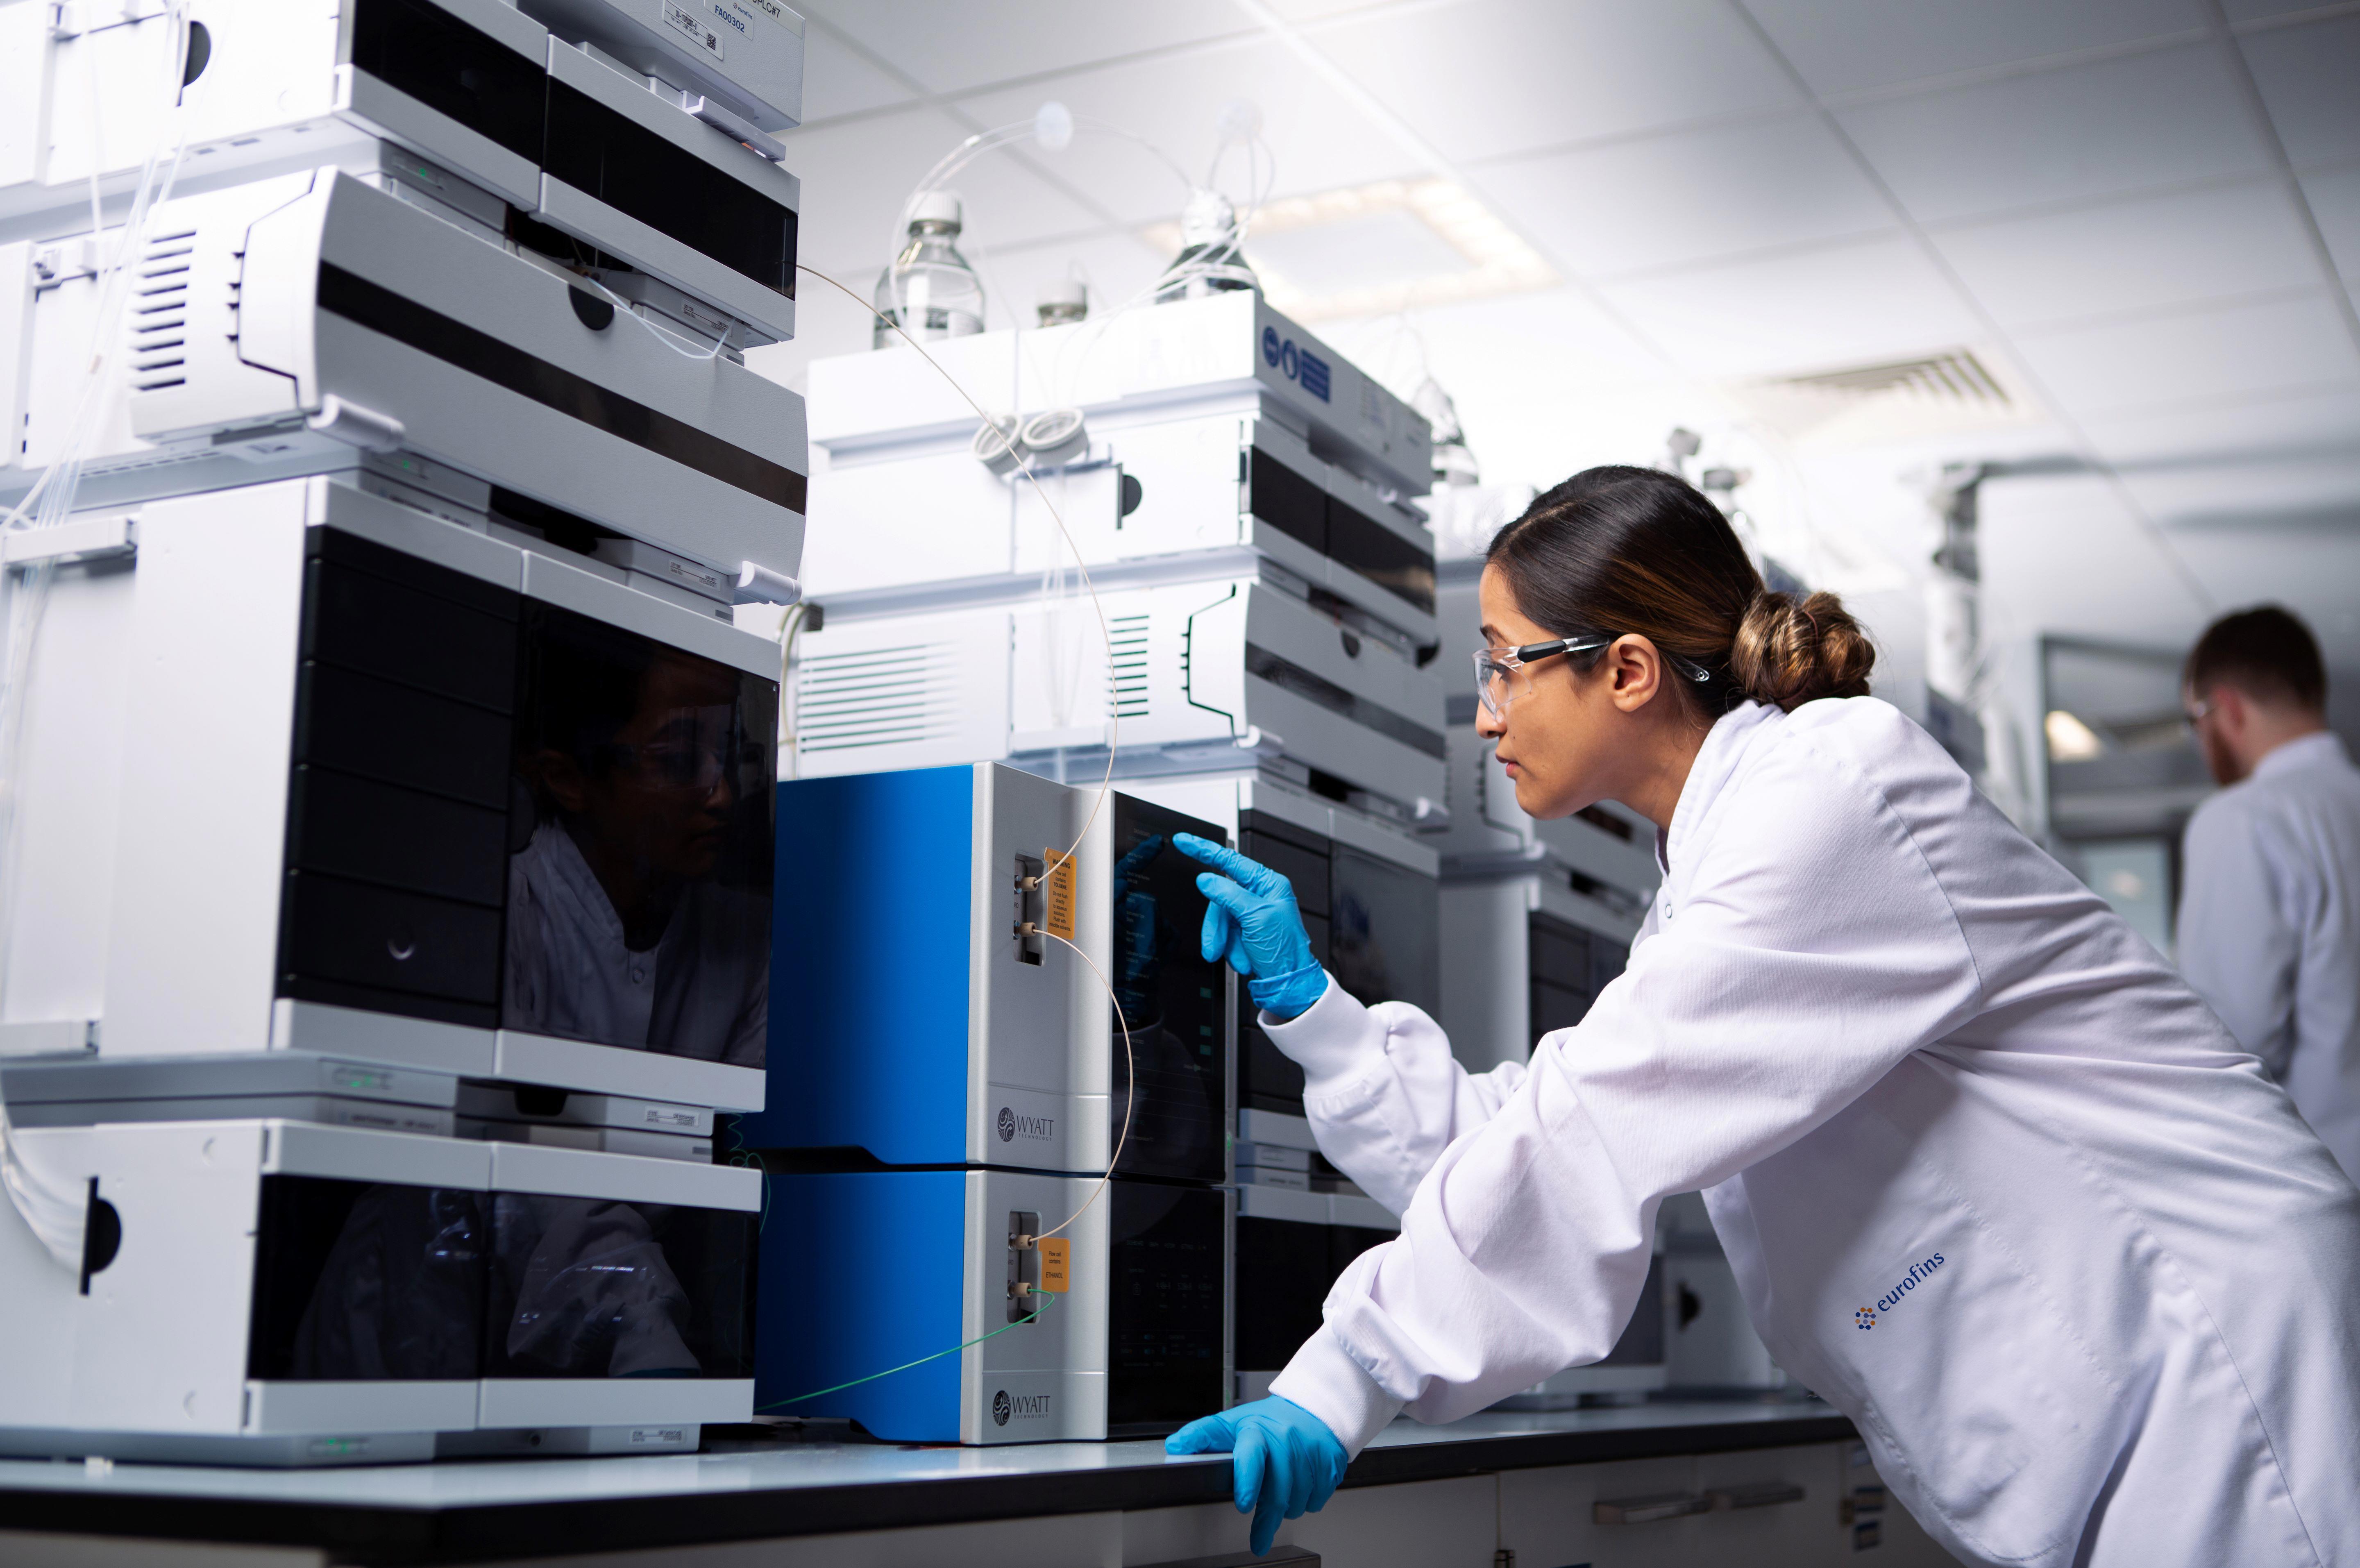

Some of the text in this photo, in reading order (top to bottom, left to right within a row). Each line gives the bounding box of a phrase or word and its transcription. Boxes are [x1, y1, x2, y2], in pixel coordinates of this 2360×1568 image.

[715, 5, 745, 33] FA00302
[738, 7, 753, 20] eurofins
[1053, 858, 1071, 869] WANING
[1017, 1115, 1054, 1136] WYATT
[1877, 1252, 1945, 1312] eurofins
[1012, 1396, 1050, 1414] WYATT
